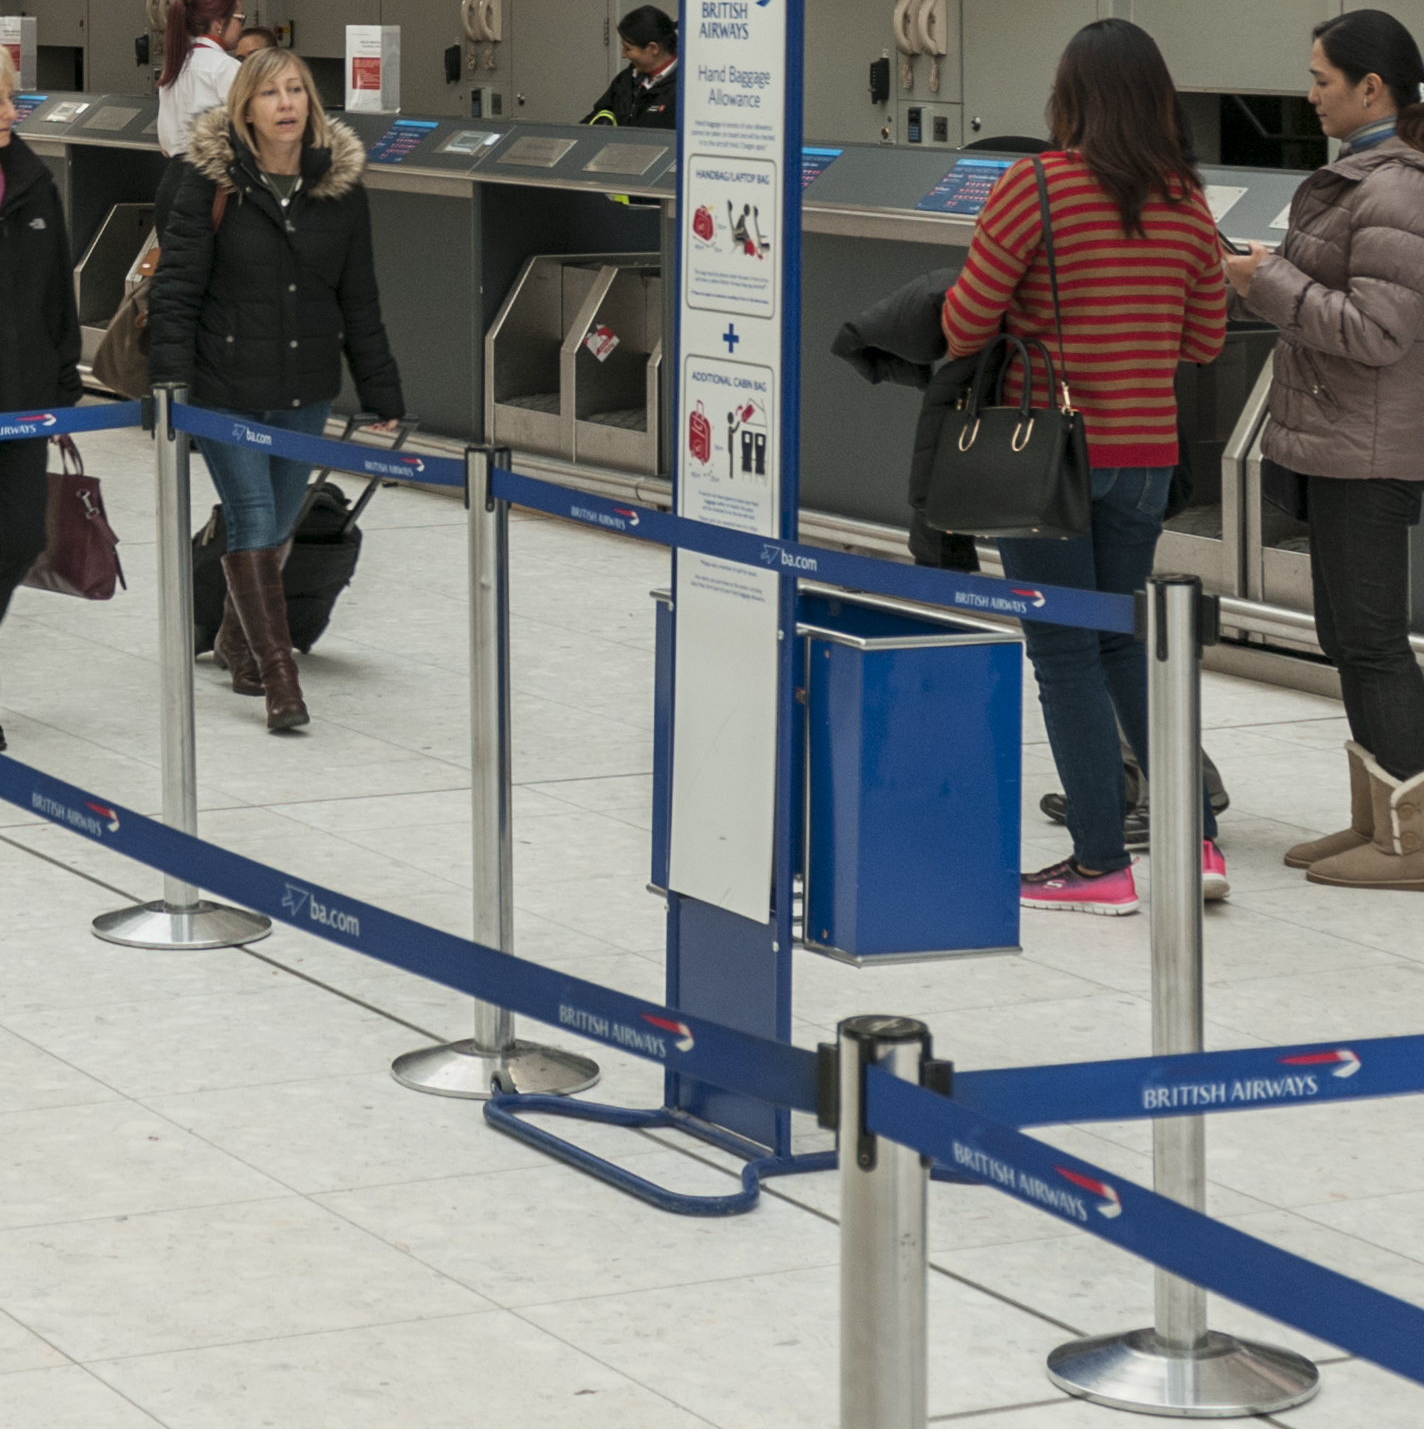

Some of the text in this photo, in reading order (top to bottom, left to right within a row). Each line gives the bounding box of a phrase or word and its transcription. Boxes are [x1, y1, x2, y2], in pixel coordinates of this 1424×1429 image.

[701, 1, 749, 20] BRITISH
[699, 22, 749, 40] AIRWAYS
[698, 65, 770, 89] Hand Baggage
[708, 89, 761, 108] Allowance
[757, 174, 770, 185] BAG
[692, 371, 767, 392] ADDITIONAL CABIN BAG
[245, 427, 272, 446] ba.com
[571, 505, 626, 531] BRITISH AIRWAYS
[781, 548, 817, 572] ba.com
[954, 591, 1027, 614] BRITISH AIRWAYS
[32, 792, 102, 837] BRITISH AIRWAYS
[309, 893, 360, 937] ba.com
[558, 1004, 667, 1059] BRITISH AIRWAYS
[1143, 1075, 1319, 1110] BRITISH AIRWAYS
[952, 1140, 1088, 1222] BRITISH AIRWAYS
